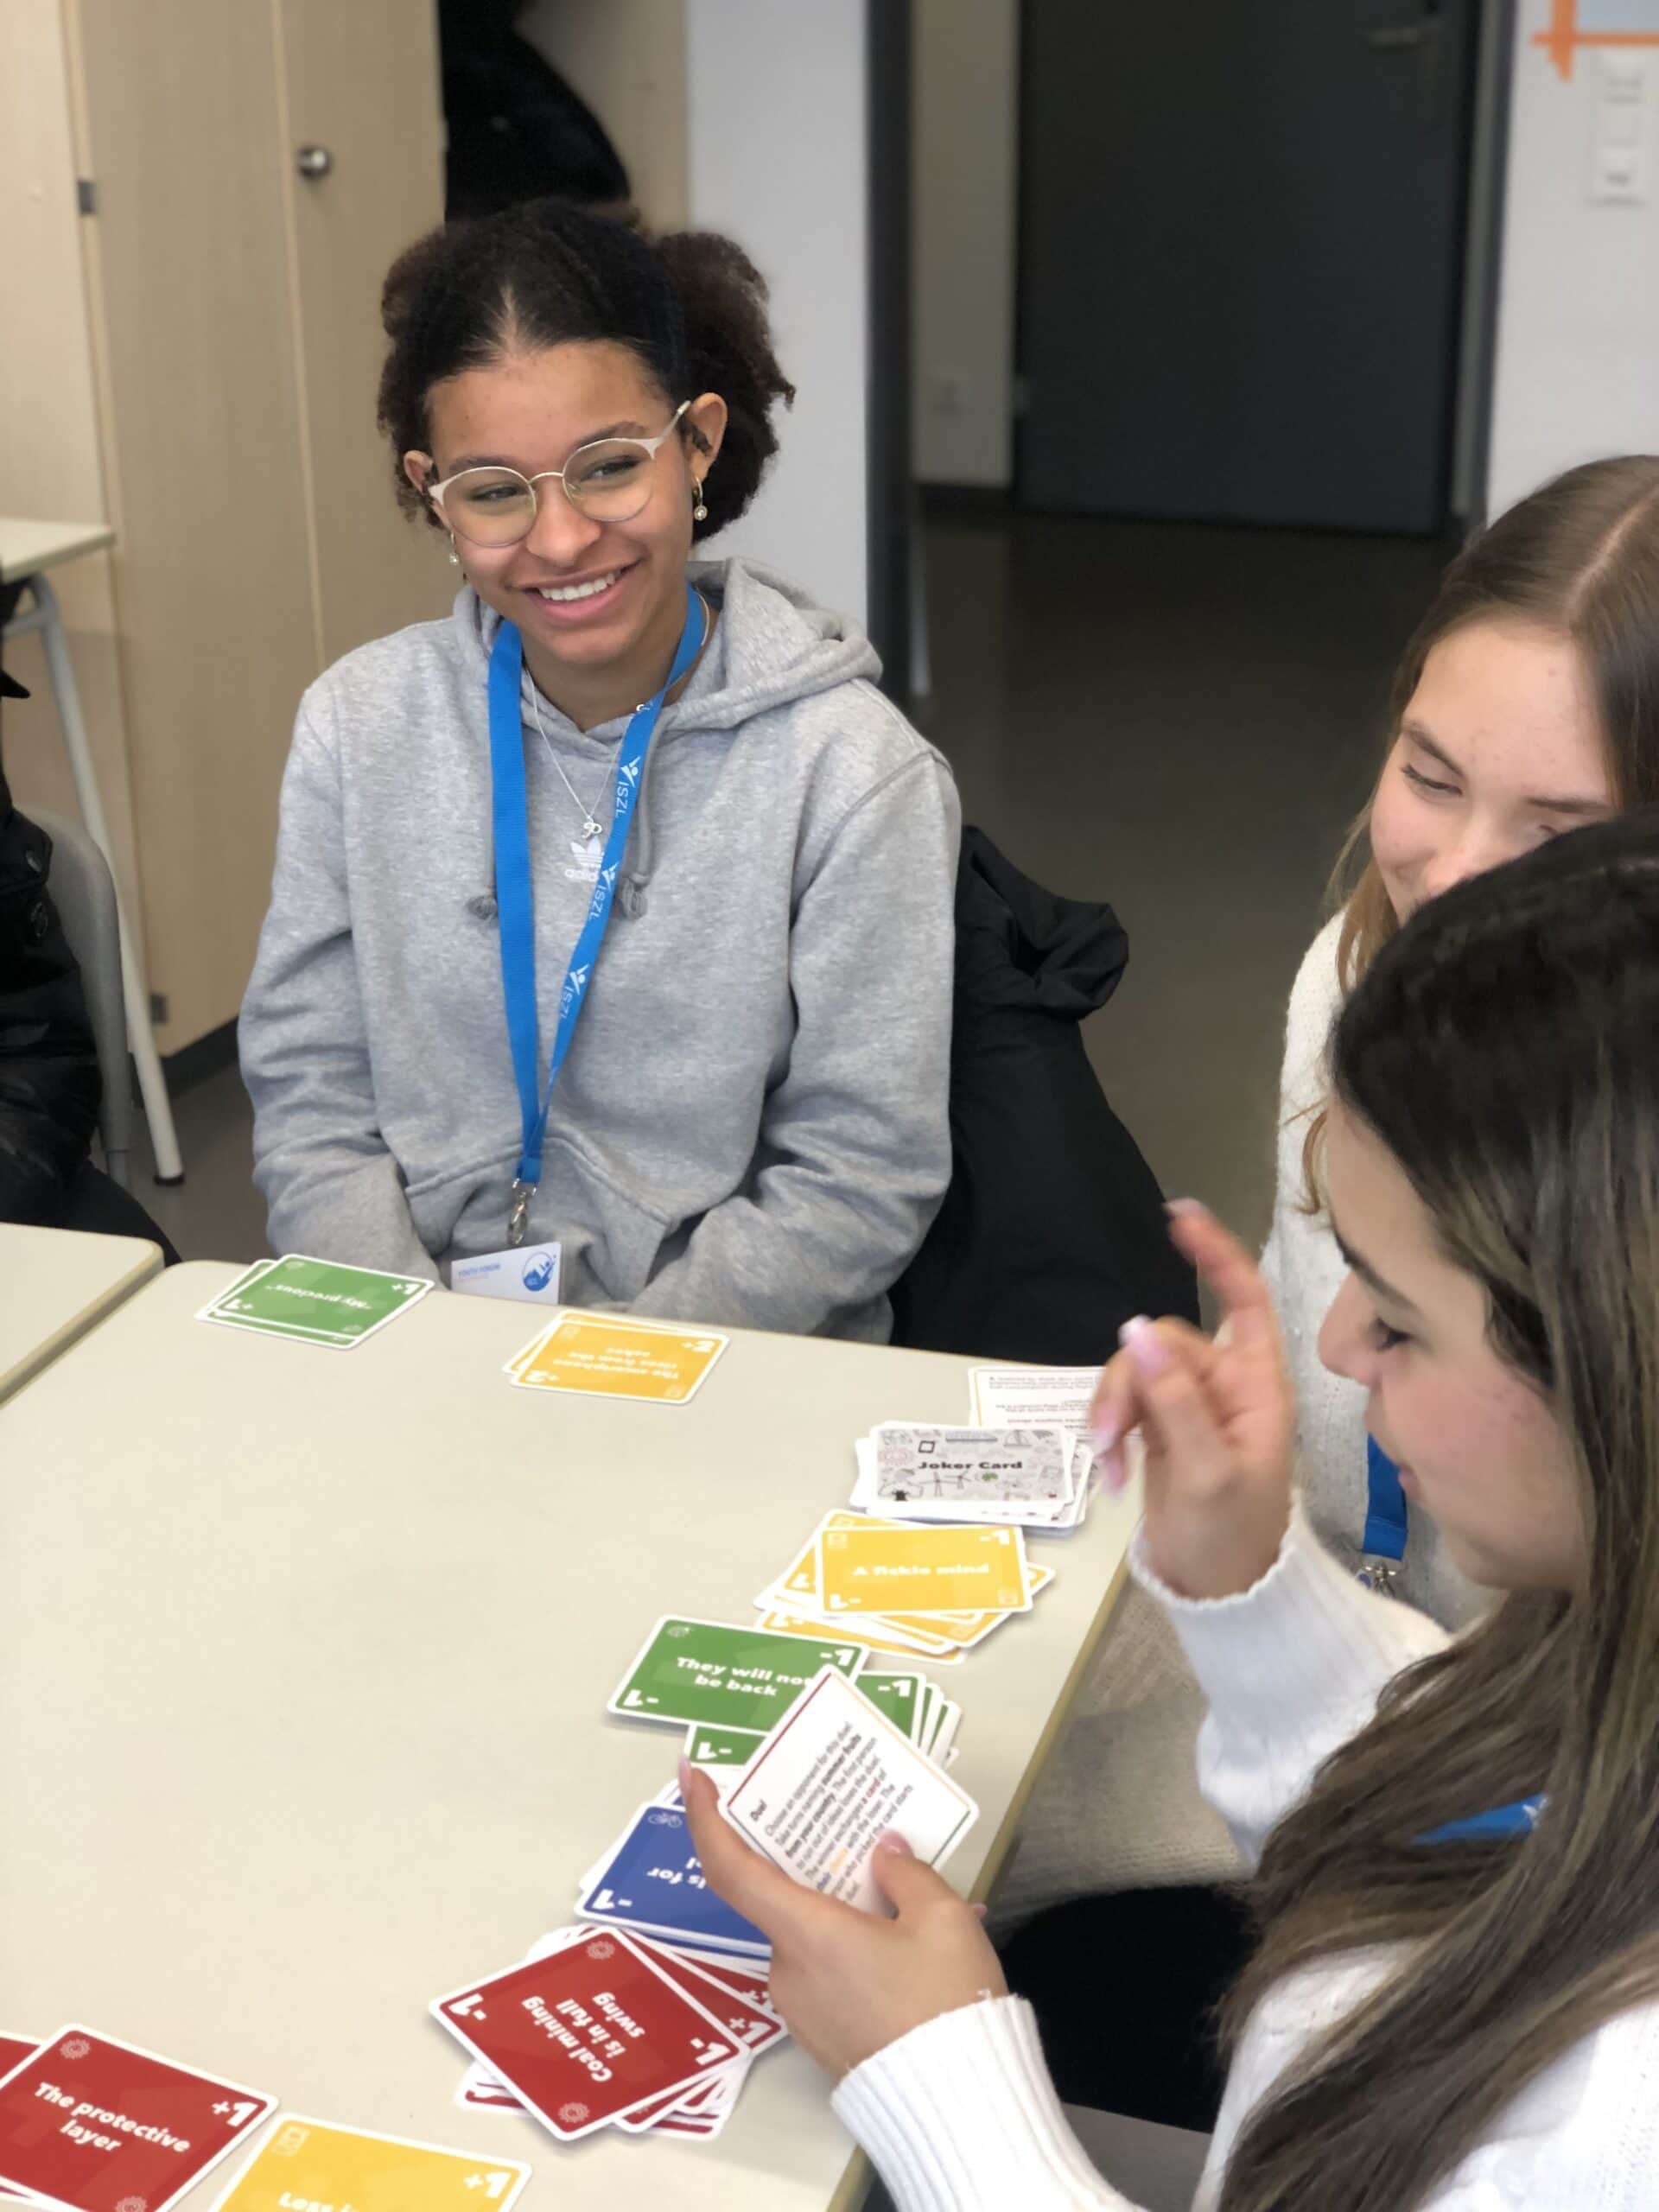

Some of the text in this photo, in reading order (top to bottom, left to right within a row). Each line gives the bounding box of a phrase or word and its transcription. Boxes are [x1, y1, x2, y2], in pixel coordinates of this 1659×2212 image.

[615, 780, 629, 817] ISZL
[591, 885, 607, 918] ISZL
[918, 1461, 1023, 1471] Joker Card
[978, 1529, 1009, 1546] -1
[852, 1565, 869, 1577] A
[936, 1563, 990, 1575] mind
[676, 1656, 727, 1676] They
[730, 1666, 774, 1681] will
[819, 1648, 855, 1666] -1
[623, 1689, 659, 1707] -1
[694, 1675, 778, 1697] be back
[877, 1680, 912, 1698] -1
[696, 1742, 732, 1760] -1
[647, 1867, 683, 1885] for
[591, 1889, 632, 1911] -1
[448, 1993, 488, 2021] -1
[592, 1991, 646, 2039] swing
[522, 1995, 613, 2082] Coal mining
[556, 1998, 626, 2059] is in full
[728, 2017, 772, 2044] +1
[690, 2037, 732, 2066] -1
[35, 2082, 191, 2152] The protective
[211, 2101, 258, 2127] +1
[60, 2119, 122, 2152] layer
[463, 2171, 512, 2199] +1
